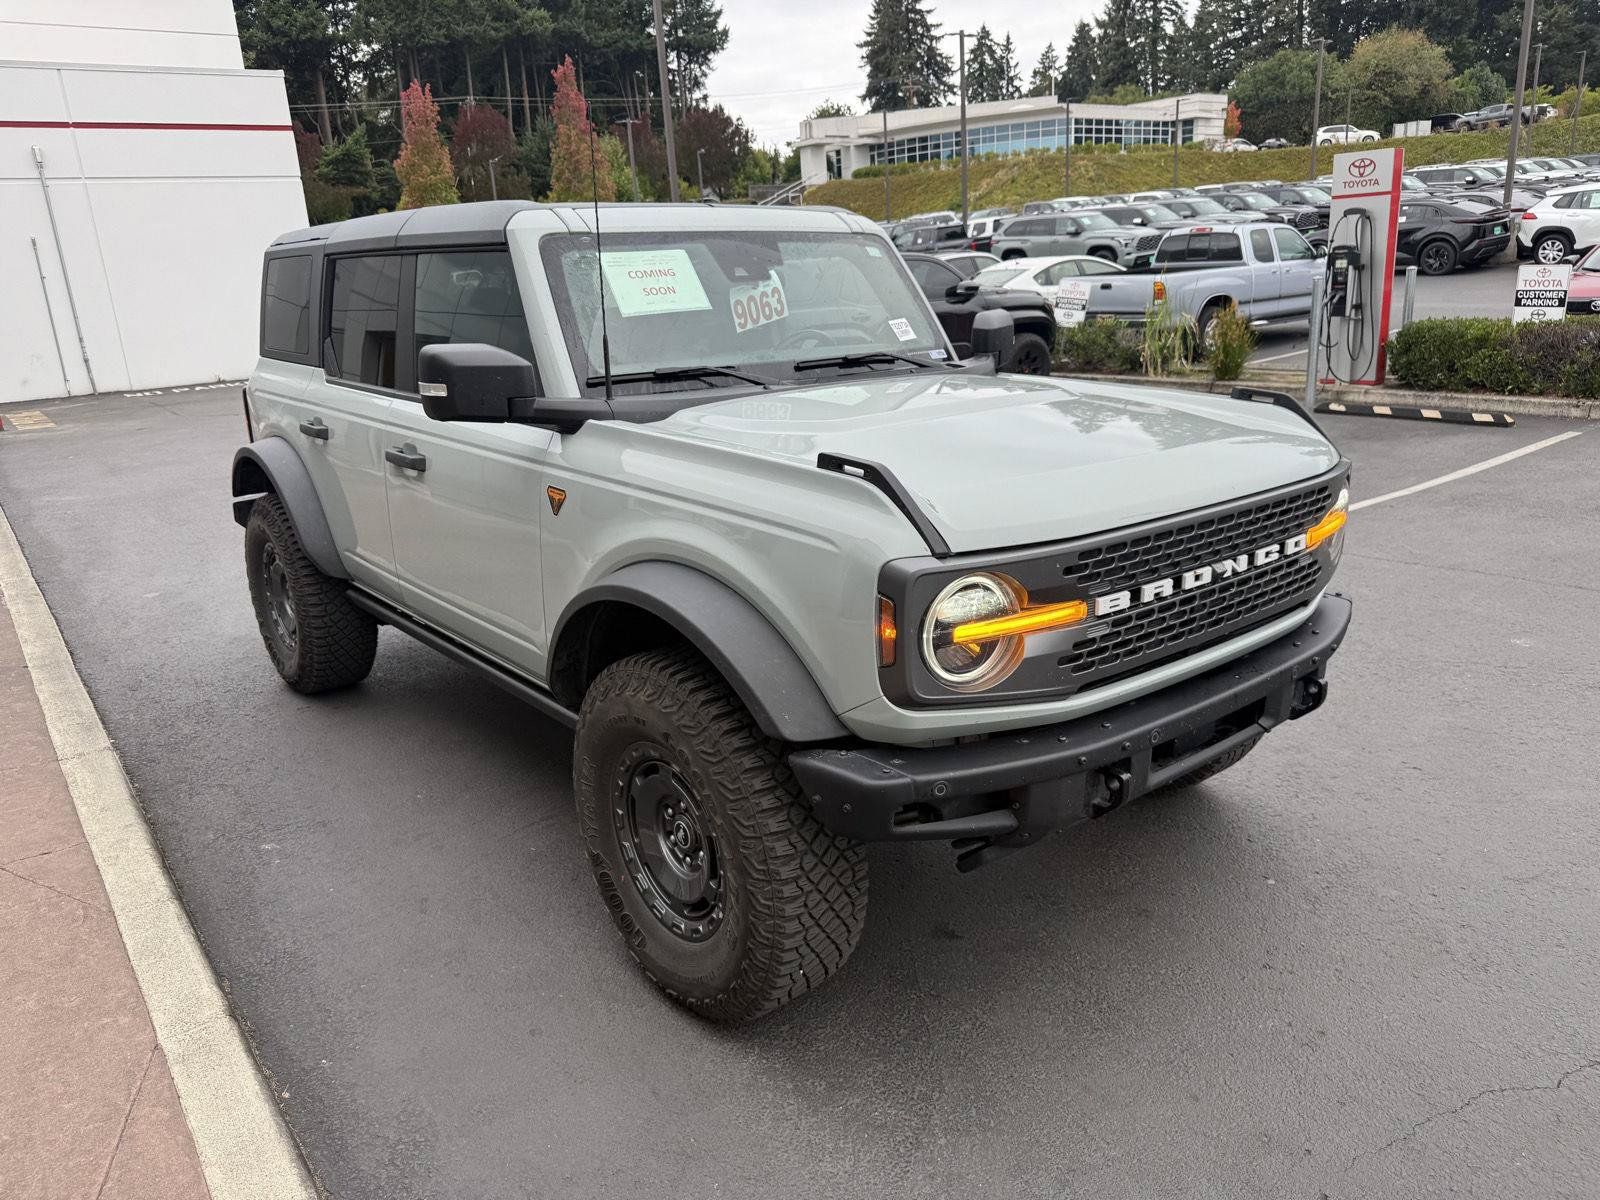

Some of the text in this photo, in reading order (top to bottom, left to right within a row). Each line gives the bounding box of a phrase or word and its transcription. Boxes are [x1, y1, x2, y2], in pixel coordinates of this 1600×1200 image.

[1342, 178, 1380, 189] TOYOTA
[628, 268, 676, 279] COMING
[1522, 279, 1563, 288] TOYOTA
[643, 286, 676, 296] SOON
[1517, 290, 1565, 299] CUSTOMER
[1521, 298, 1559, 306] PARKING
[733, 287, 784, 329] 9063
[1095, 534, 1307, 616] BRONCO
